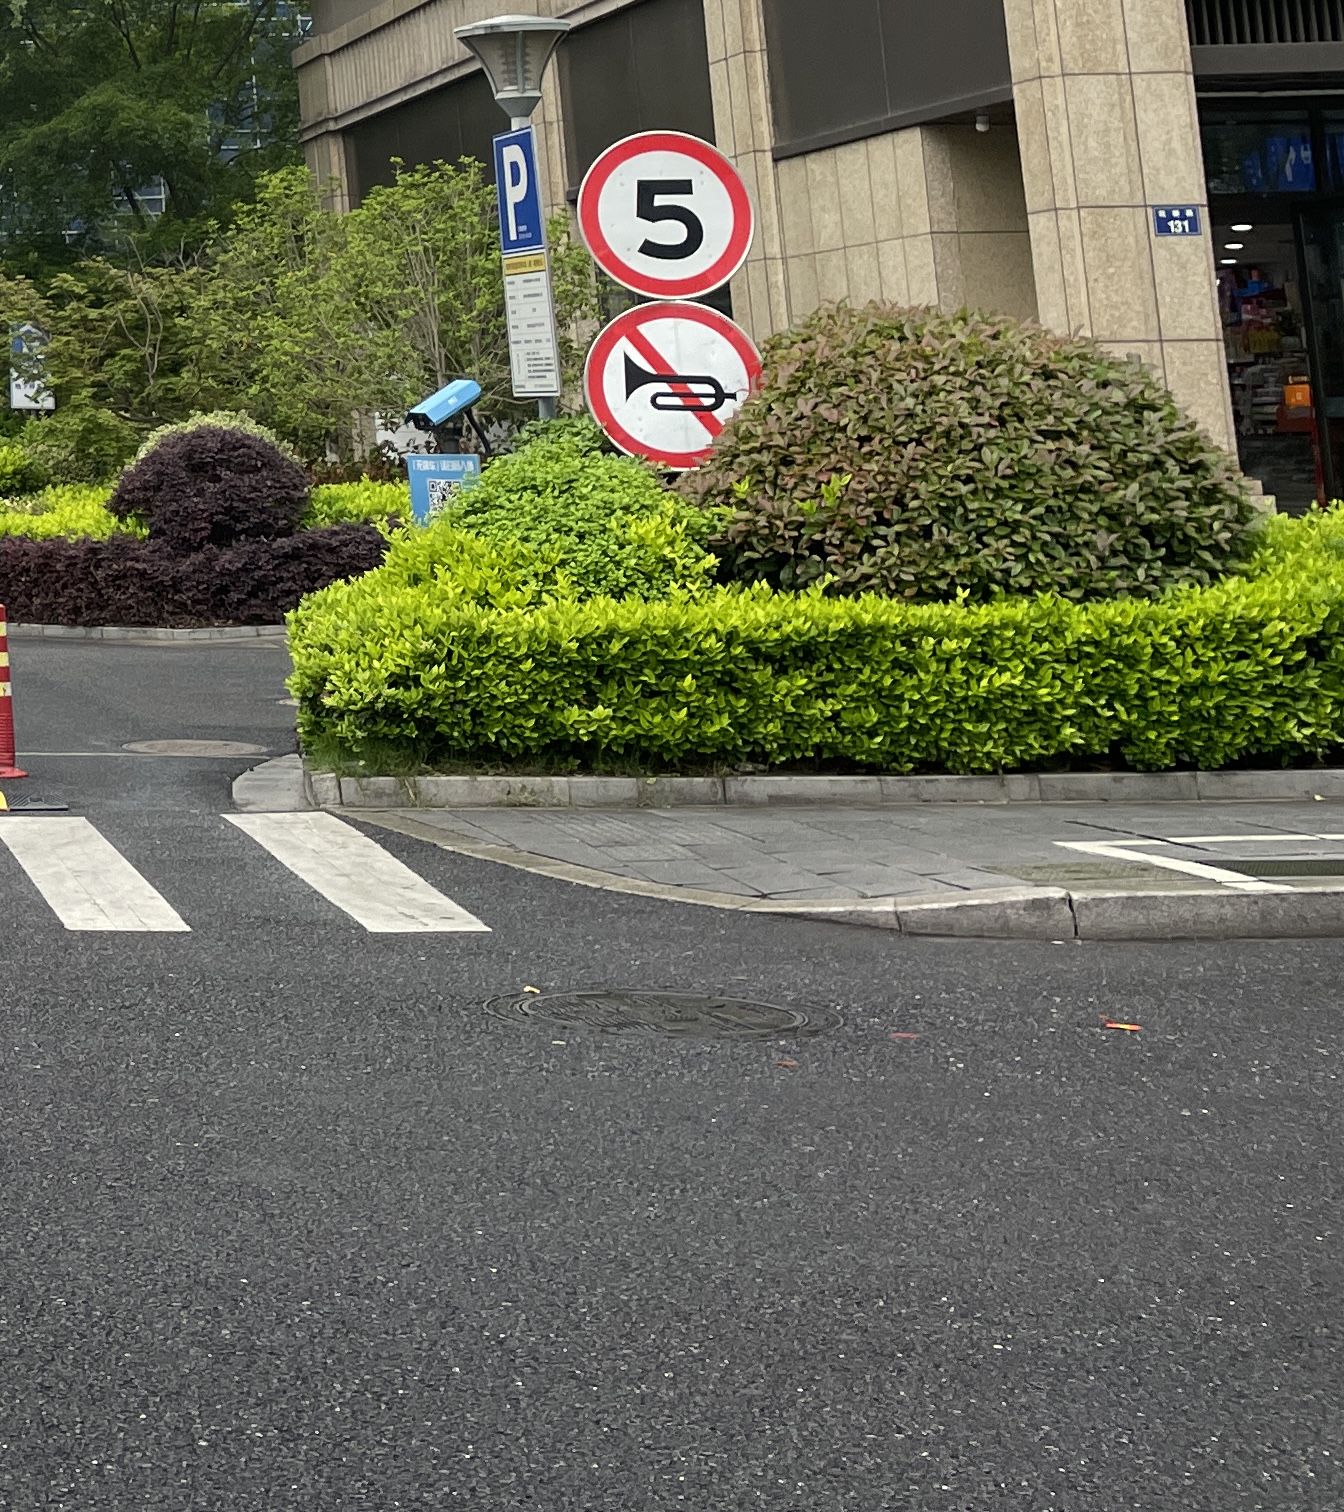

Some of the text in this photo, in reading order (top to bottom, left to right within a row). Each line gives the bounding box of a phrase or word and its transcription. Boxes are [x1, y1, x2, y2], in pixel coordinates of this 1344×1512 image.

[502, 144, 529, 241] P
[636, 179, 703, 260] 5
[1167, 219, 1189, 233] 131
